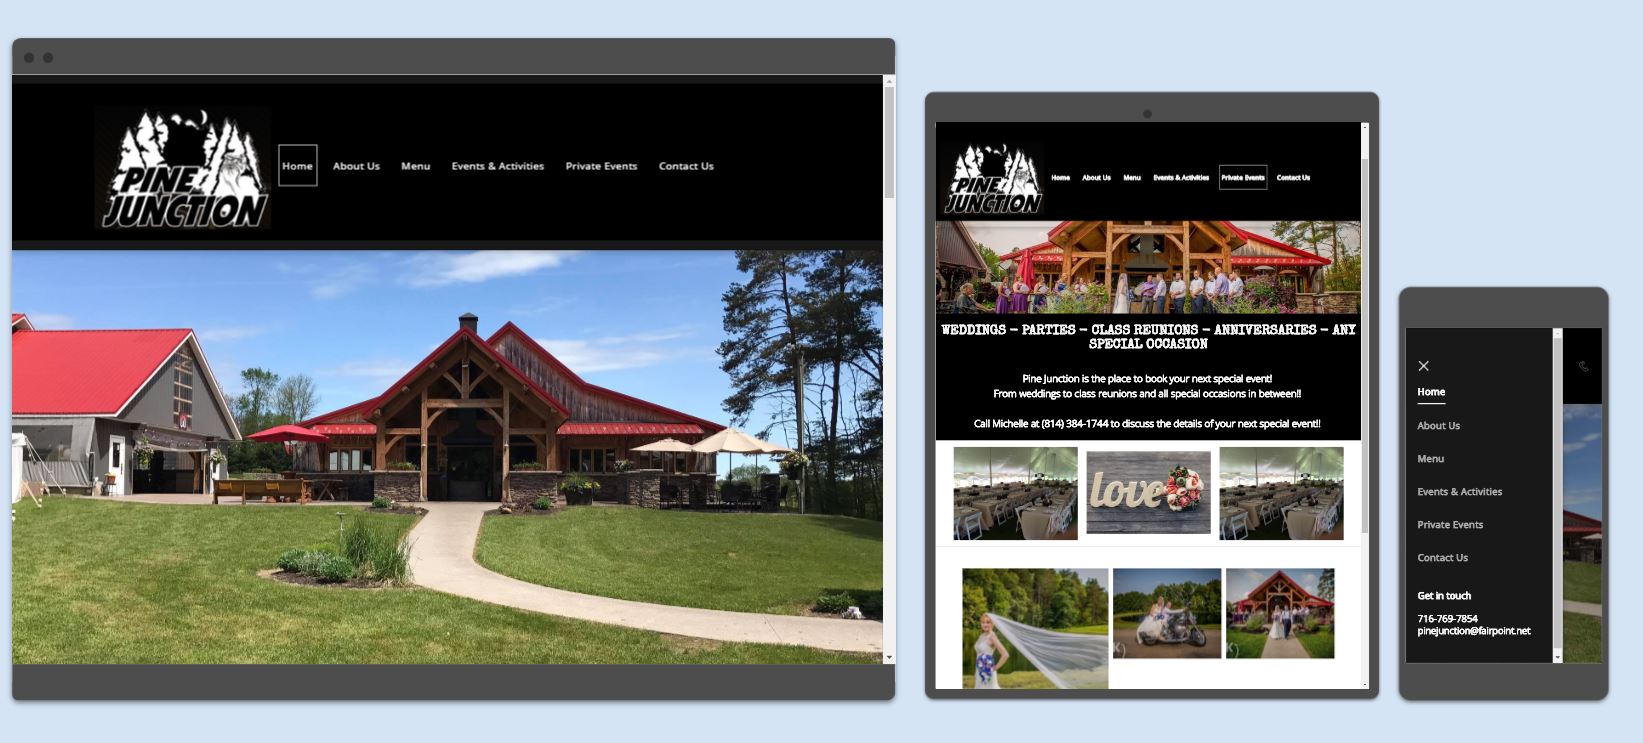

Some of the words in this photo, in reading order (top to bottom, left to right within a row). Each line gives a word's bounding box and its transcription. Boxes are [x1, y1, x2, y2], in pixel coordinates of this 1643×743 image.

[283, 161, 314, 171] Home
[332, 161, 365, 171] About
[366, 161, 381, 171] Us
[401, 161, 431, 171] Menu
[451, 161, 486, 171] Events
[487, 161, 497, 171] &
[498, 161, 545, 171] Activities
[565, 161, 602, 171] Private
[604, 161, 638, 171] Events
[658, 161, 699, 171] Contact
[700, 161, 715, 171] Us
[119, 165, 201, 194] PINE
[1051, 174, 1071, 182] Home
[1081, 174, 1102, 182] About
[1102, 174, 1112, 182] Us
[1123, 174, 1142, 182] Menu
[1153, 173, 1175, 182] Events
[1181, 173, 1210, 182] Activities
[1221, 174, 1244, 182] Private
[1244, 174, 1266, 182] Events
[1276, 174, 1302, 182] Contact
[1301, 174, 1311, 182] Us
[955, 176, 1002, 194] PINE
[944, 193, 1043, 214] JUNCTION
[102, 193, 269, 228] JUNCTION
[940, 323, 1007, 336] WEDDINGS
[1021, 323, 1077, 336] PARTIES
[1091, 323, 1131, 336] CLASS
[1133, 323, 1199, 336] REUNIONS
[1213, 323, 1318, 336] ANNIVERSARIES
[1331, 323, 1357, 336] ANY
[1088, 337, 1144, 350] SPECIAL
[1145, 337, 1209, 350] OCCASION
[1022, 373, 1043, 384] Pine
[1041, 373, 1080, 385] Junction
[1081, 373, 1090, 384] is
[1090, 373, 1107, 384] the
[1107, 373, 1132, 386] place
[1132, 374, 1144, 384] to
[1145, 373, 1169, 384] book
[1168, 375, 1191, 386] your
[1191, 374, 1212, 384] next
[1212, 373, 1244, 386] special
[1245, 373, 1273, 384] event!
[993, 388, 1017, 399] From
[1018, 388, 1062, 401] weddings
[1062, 389, 1073, 399] to
[1073, 388, 1097, 399] class
[1098, 388, 1138, 399] reunions
[1138, 388, 1157, 399] and
[1157, 388, 1169, 399] all
[1170, 388, 1201, 401] special
[1202, 388, 1247, 399] occasions
[1247, 388, 1257, 399] in
[1258, 388, 1302, 399] between!!
[1417, 387, 1446, 397] Home
[973, 418, 991, 429] Call
[992, 418, 1029, 429] Michelle
[1030, 419, 1041, 429] at
[1041, 418, 1065, 430] (814)
[1065, 418, 1110, 429] 384-1744
[1109, 419, 1121, 429] to
[1121, 418, 1155, 429] discuss
[1155, 418, 1172, 429] the
[1172, 418, 1203, 429] details
[1203, 418, 1215, 429] of
[1214, 420, 1237, 431] your
[1237, 419, 1258, 429] next
[1258, 418, 1290, 431] special
[1291, 418, 1321, 429] event!!
[1416, 420, 1447, 431] About
[1448, 421, 1461, 431] Us
[1417, 454, 1445, 464] Menu
[1090, 471, 1164, 508] love
[1417, 487, 1449, 497] Events
[1450, 487, 1459, 497] &
[1460, 487, 1503, 497] Activities
[1417, 520, 1451, 530] Private
[1452, 520, 1484, 530] Events
[1417, 553, 1455, 563] Contact
[1455, 553, 1469, 563] Us
[1417, 591, 1435, 601] Get
[1435, 591, 1445, 601] in
[1445, 590, 1472, 601] touch
[1417, 614, 1479, 624] 716-769-7854
[1417, 625, 1532, 638] pinejunction@fairpoint.net
